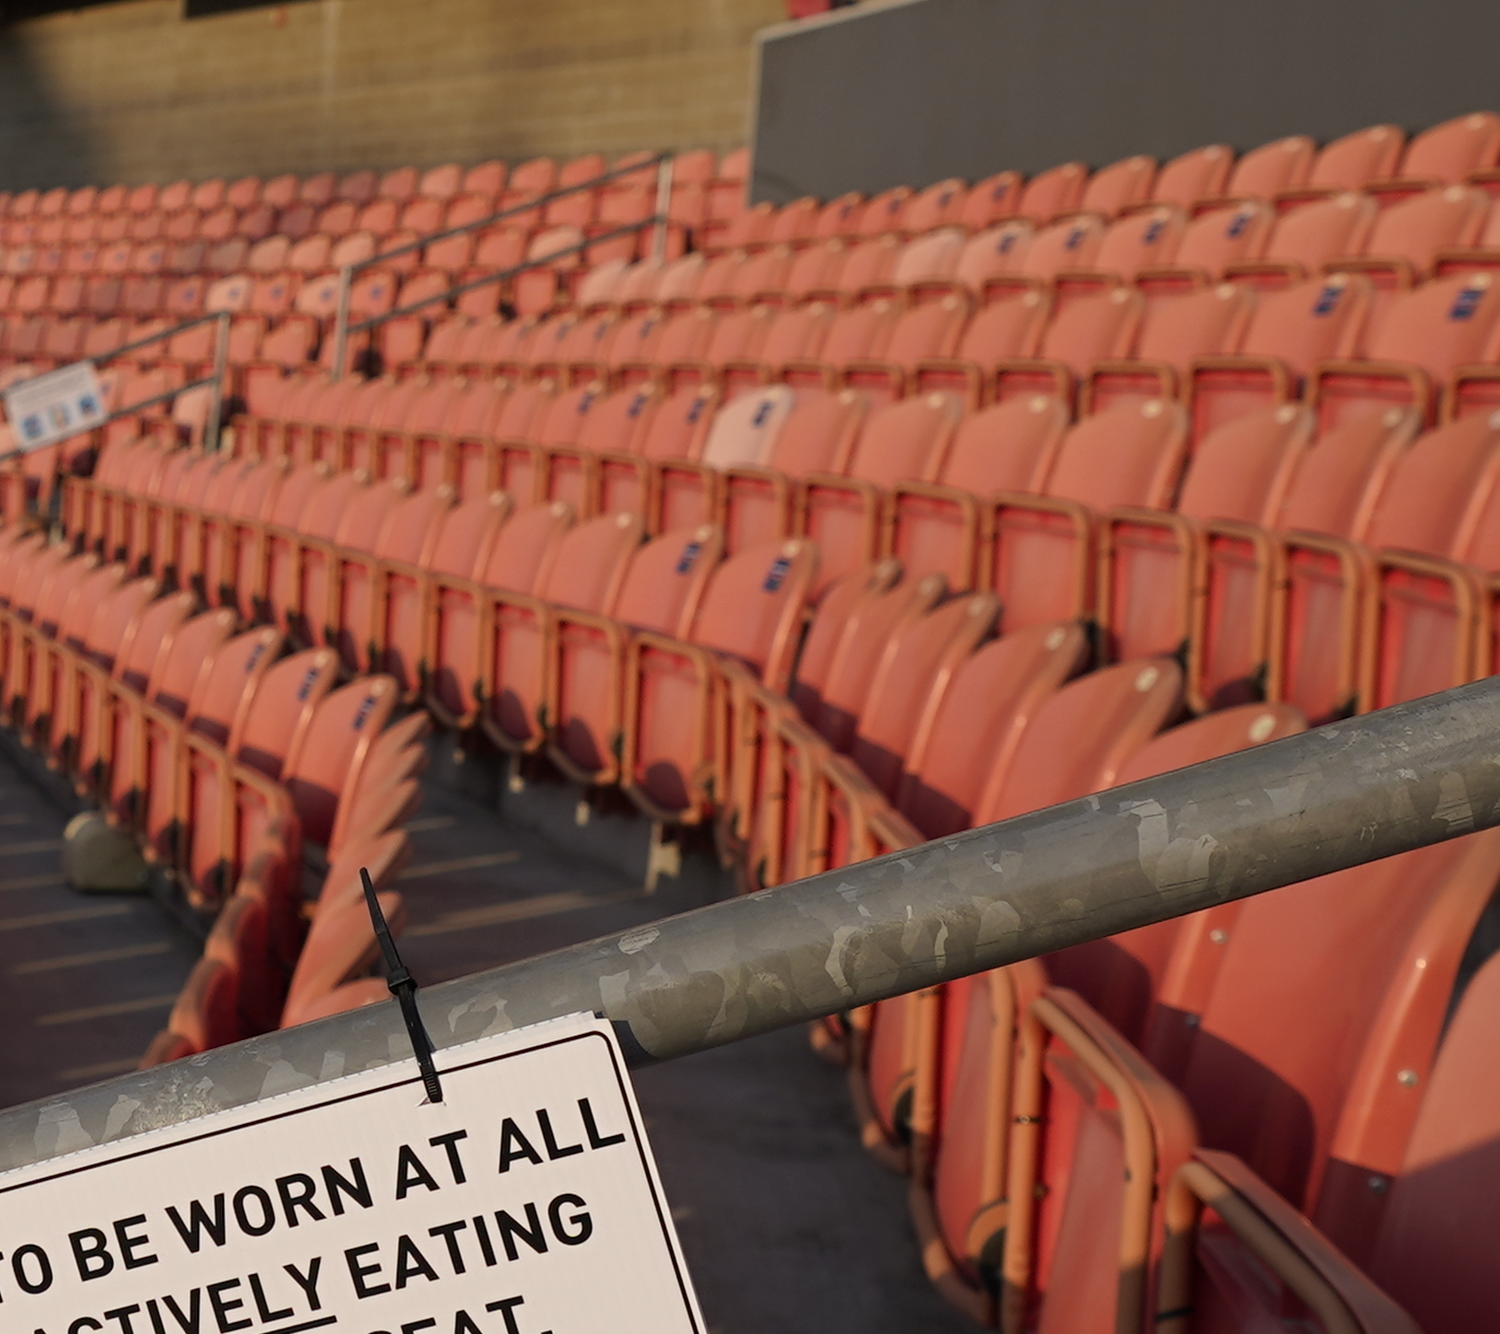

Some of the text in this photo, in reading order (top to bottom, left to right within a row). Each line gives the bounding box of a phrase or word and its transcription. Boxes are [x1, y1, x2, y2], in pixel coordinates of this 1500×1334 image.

[67, 1212, 159, 1282] BE
[163, 1156, 374, 1254] WORN
[394, 1128, 468, 1201] AT
[497, 1096, 626, 1174] ALL
[342, 1192, 593, 1300] EATING
